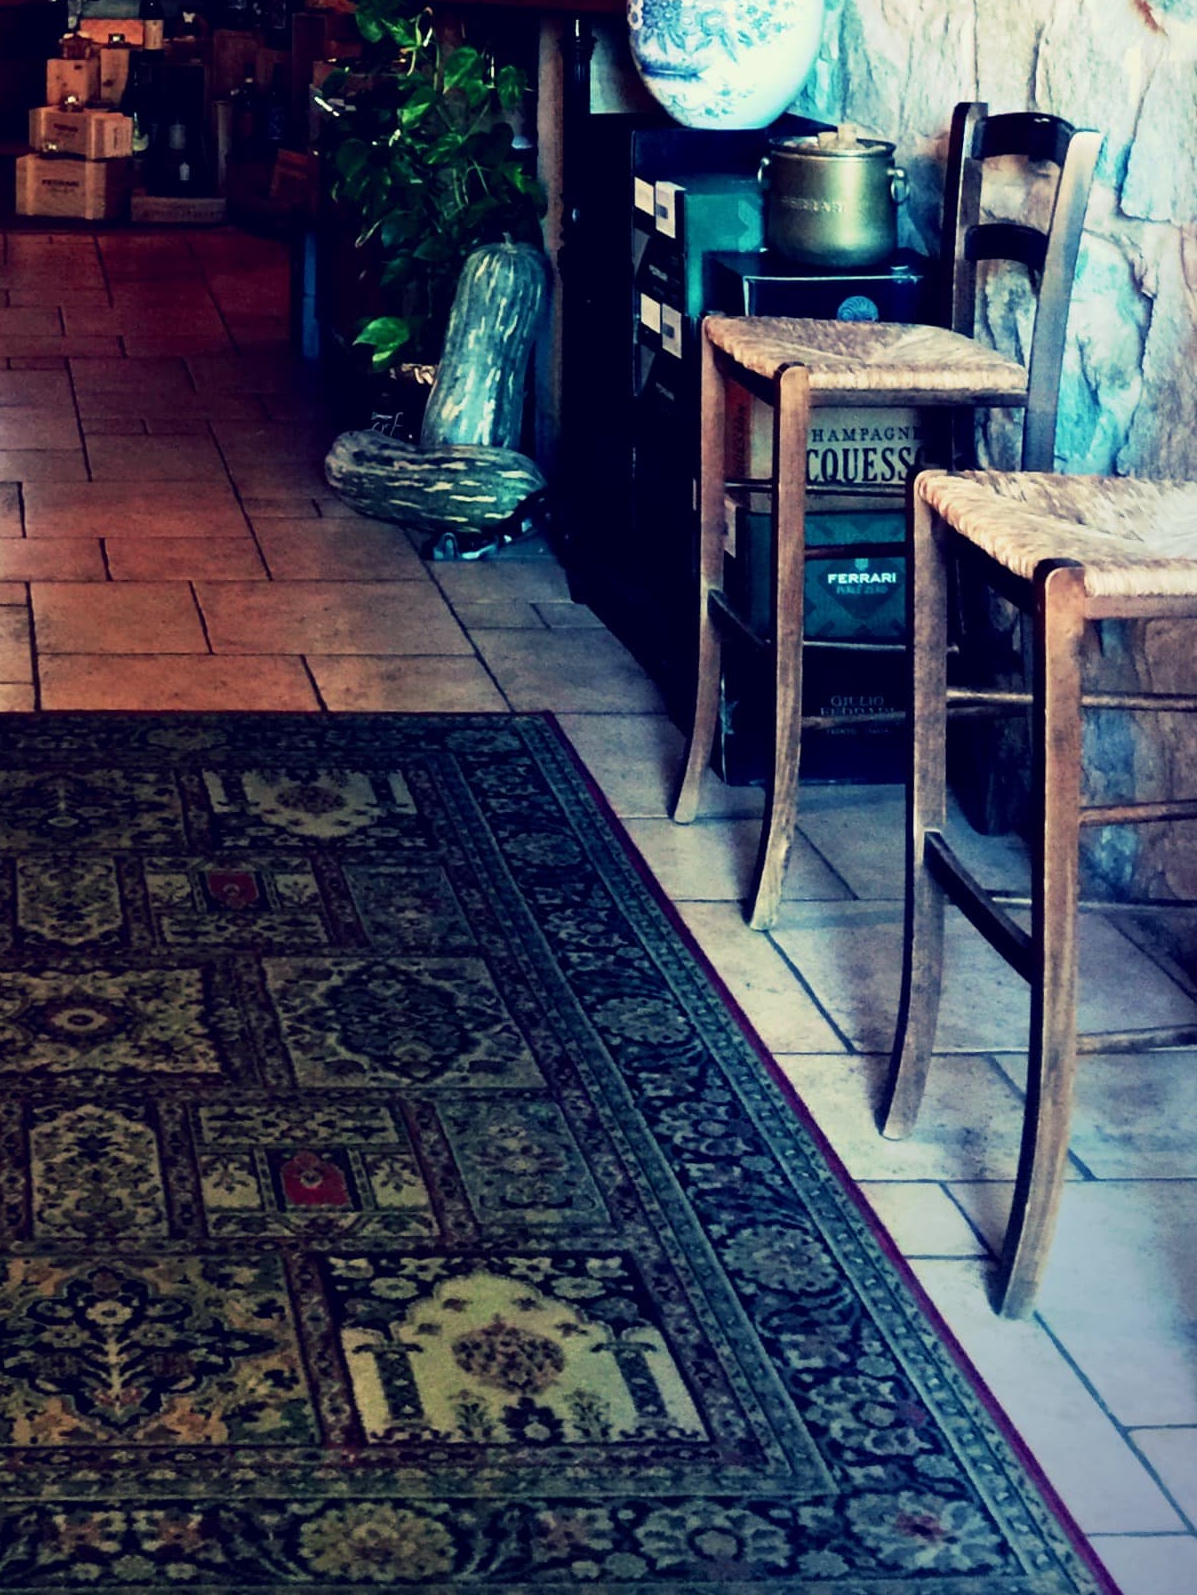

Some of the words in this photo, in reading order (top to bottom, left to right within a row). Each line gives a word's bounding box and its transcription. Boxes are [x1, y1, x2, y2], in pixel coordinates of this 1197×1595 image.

[811, 426, 922, 443] HAMPAGN
[806, 447, 922, 483] CQUESS
[827, 572, 897, 585] FERRARI
